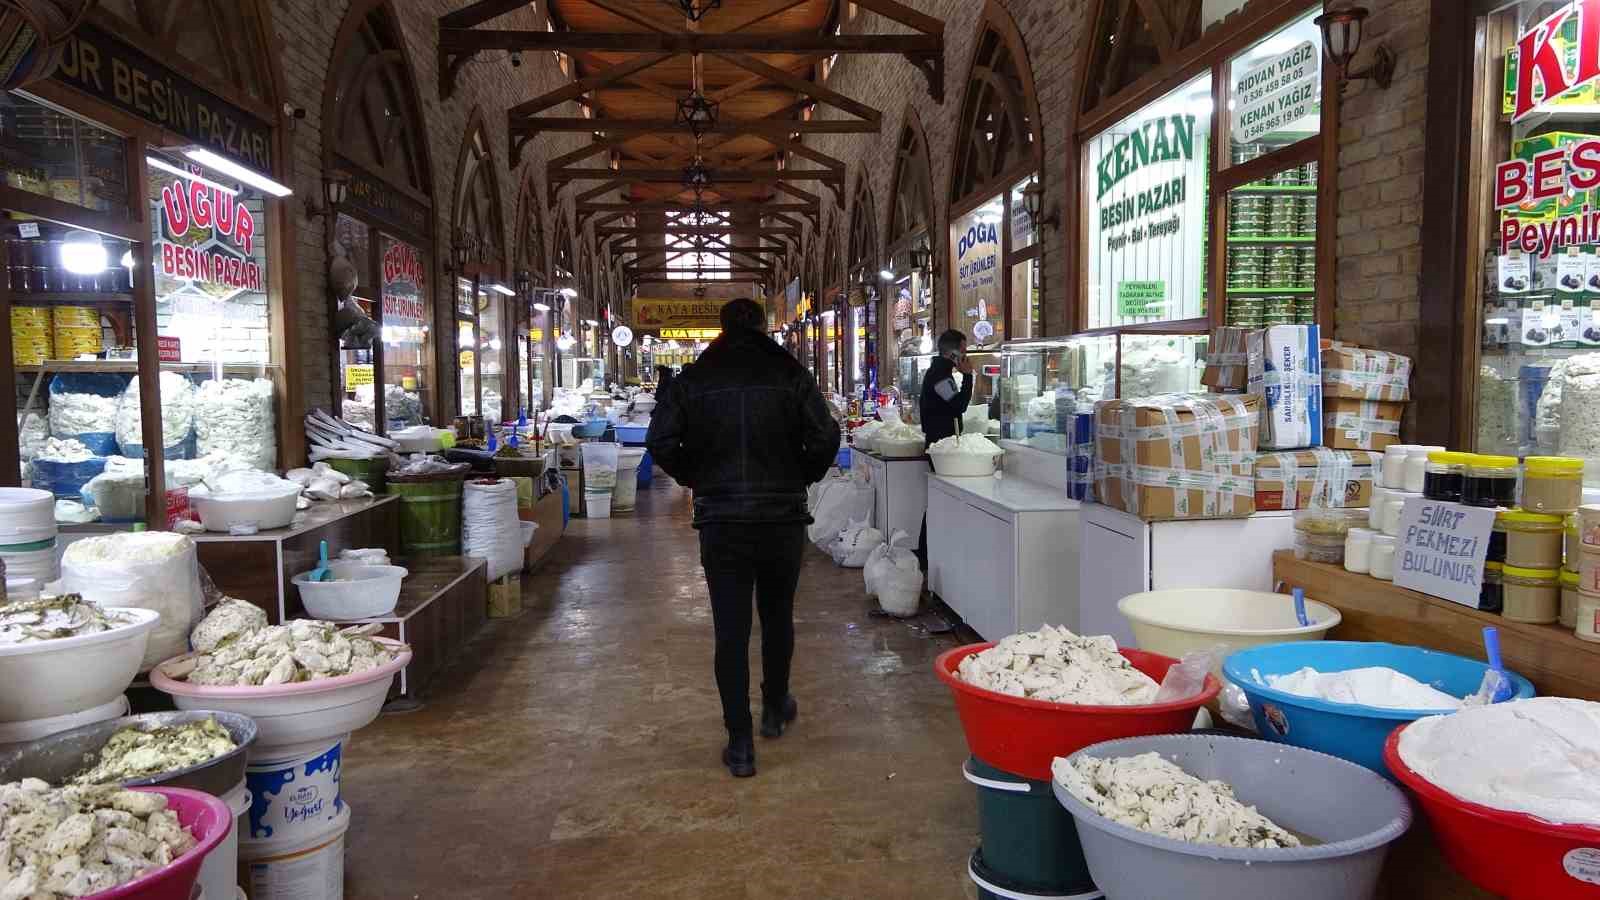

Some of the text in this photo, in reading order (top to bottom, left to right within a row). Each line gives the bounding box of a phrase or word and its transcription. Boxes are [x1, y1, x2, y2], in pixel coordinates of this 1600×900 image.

[1238, 45, 1313, 95] RIDVAN YAĞIZ
[1293, 66, 1304, 79] 05
[112, 56, 191, 129] BESİN
[196, 104, 271, 170] PAZARI
[1240, 83, 1313, 129] KENAN YAĞIZ
[1097, 113, 1196, 202] KENAN
[162, 162, 254, 256] UĞUR
[1101, 175, 1186, 232] BESİN PAZARI
[1132, 225, 1143, 244] Bal
[162, 241, 262, 292] BESİN PAZARI
[657, 303, 688, 314] KAYA
[1405, 525, 1479, 557] PEKMEZİ
[1402, 550, 1477, 586] BULUNUR
